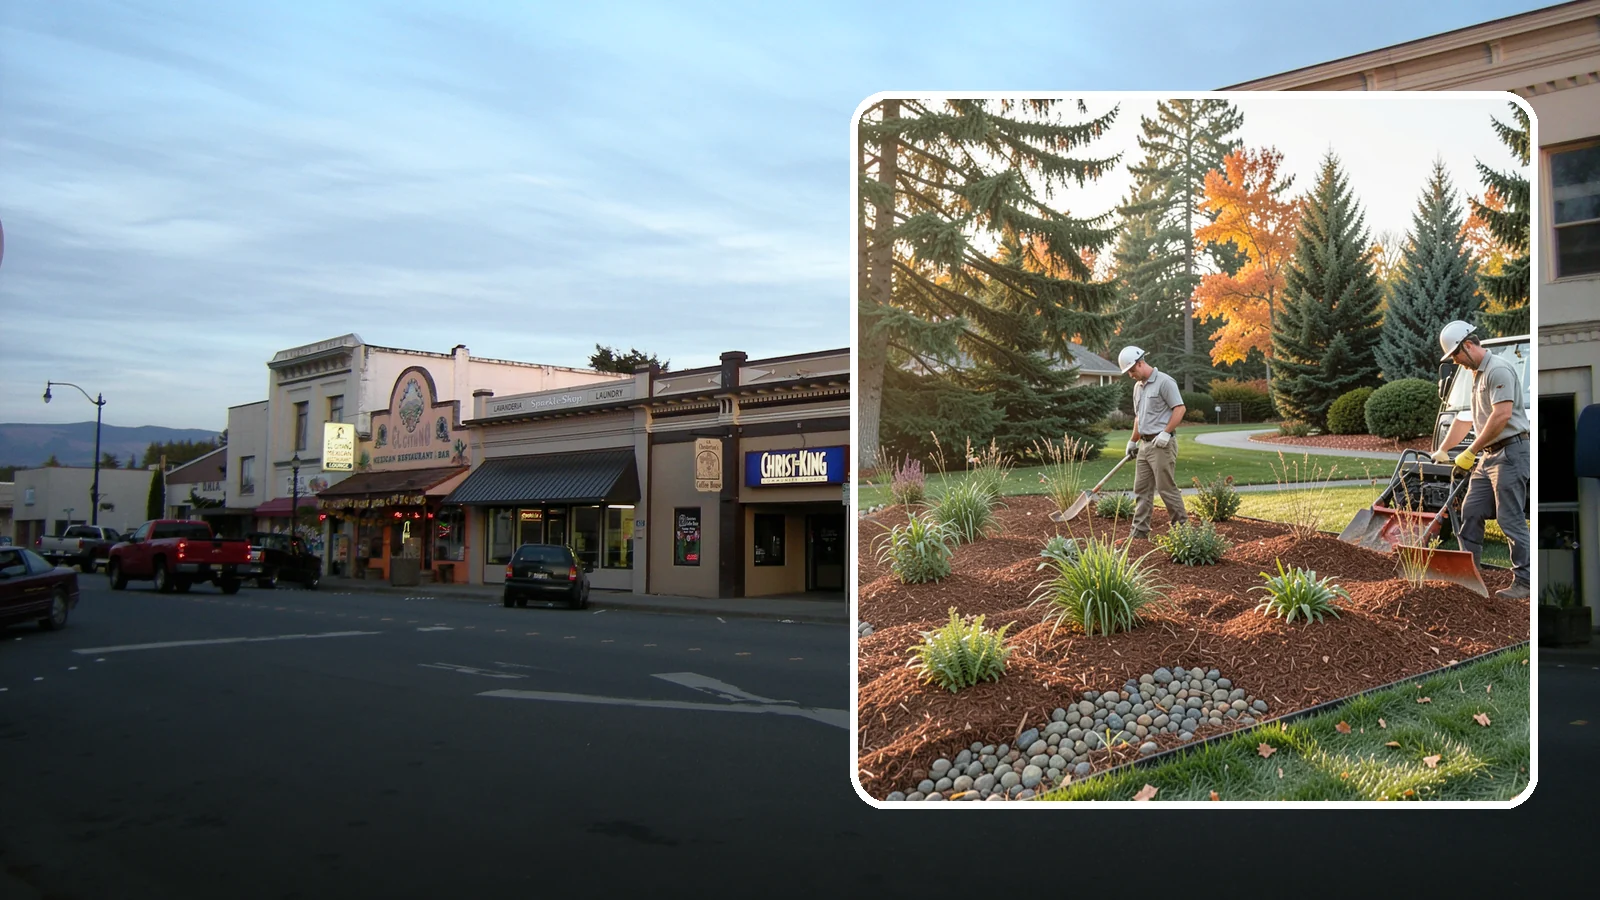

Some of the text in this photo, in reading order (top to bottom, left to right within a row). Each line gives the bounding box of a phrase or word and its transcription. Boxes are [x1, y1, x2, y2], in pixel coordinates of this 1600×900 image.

[562, 394, 583, 405] Shop
[596, 389, 624, 400] LAUNDRY
[493, 402, 522, 413] LAVANDERIA
[374, 454, 396, 464] MEXICAN
[397, 451, 433, 462] RESTAURANT
[437, 449, 450, 459] BAR
[760, 450, 827, 478] CHRIST KING
